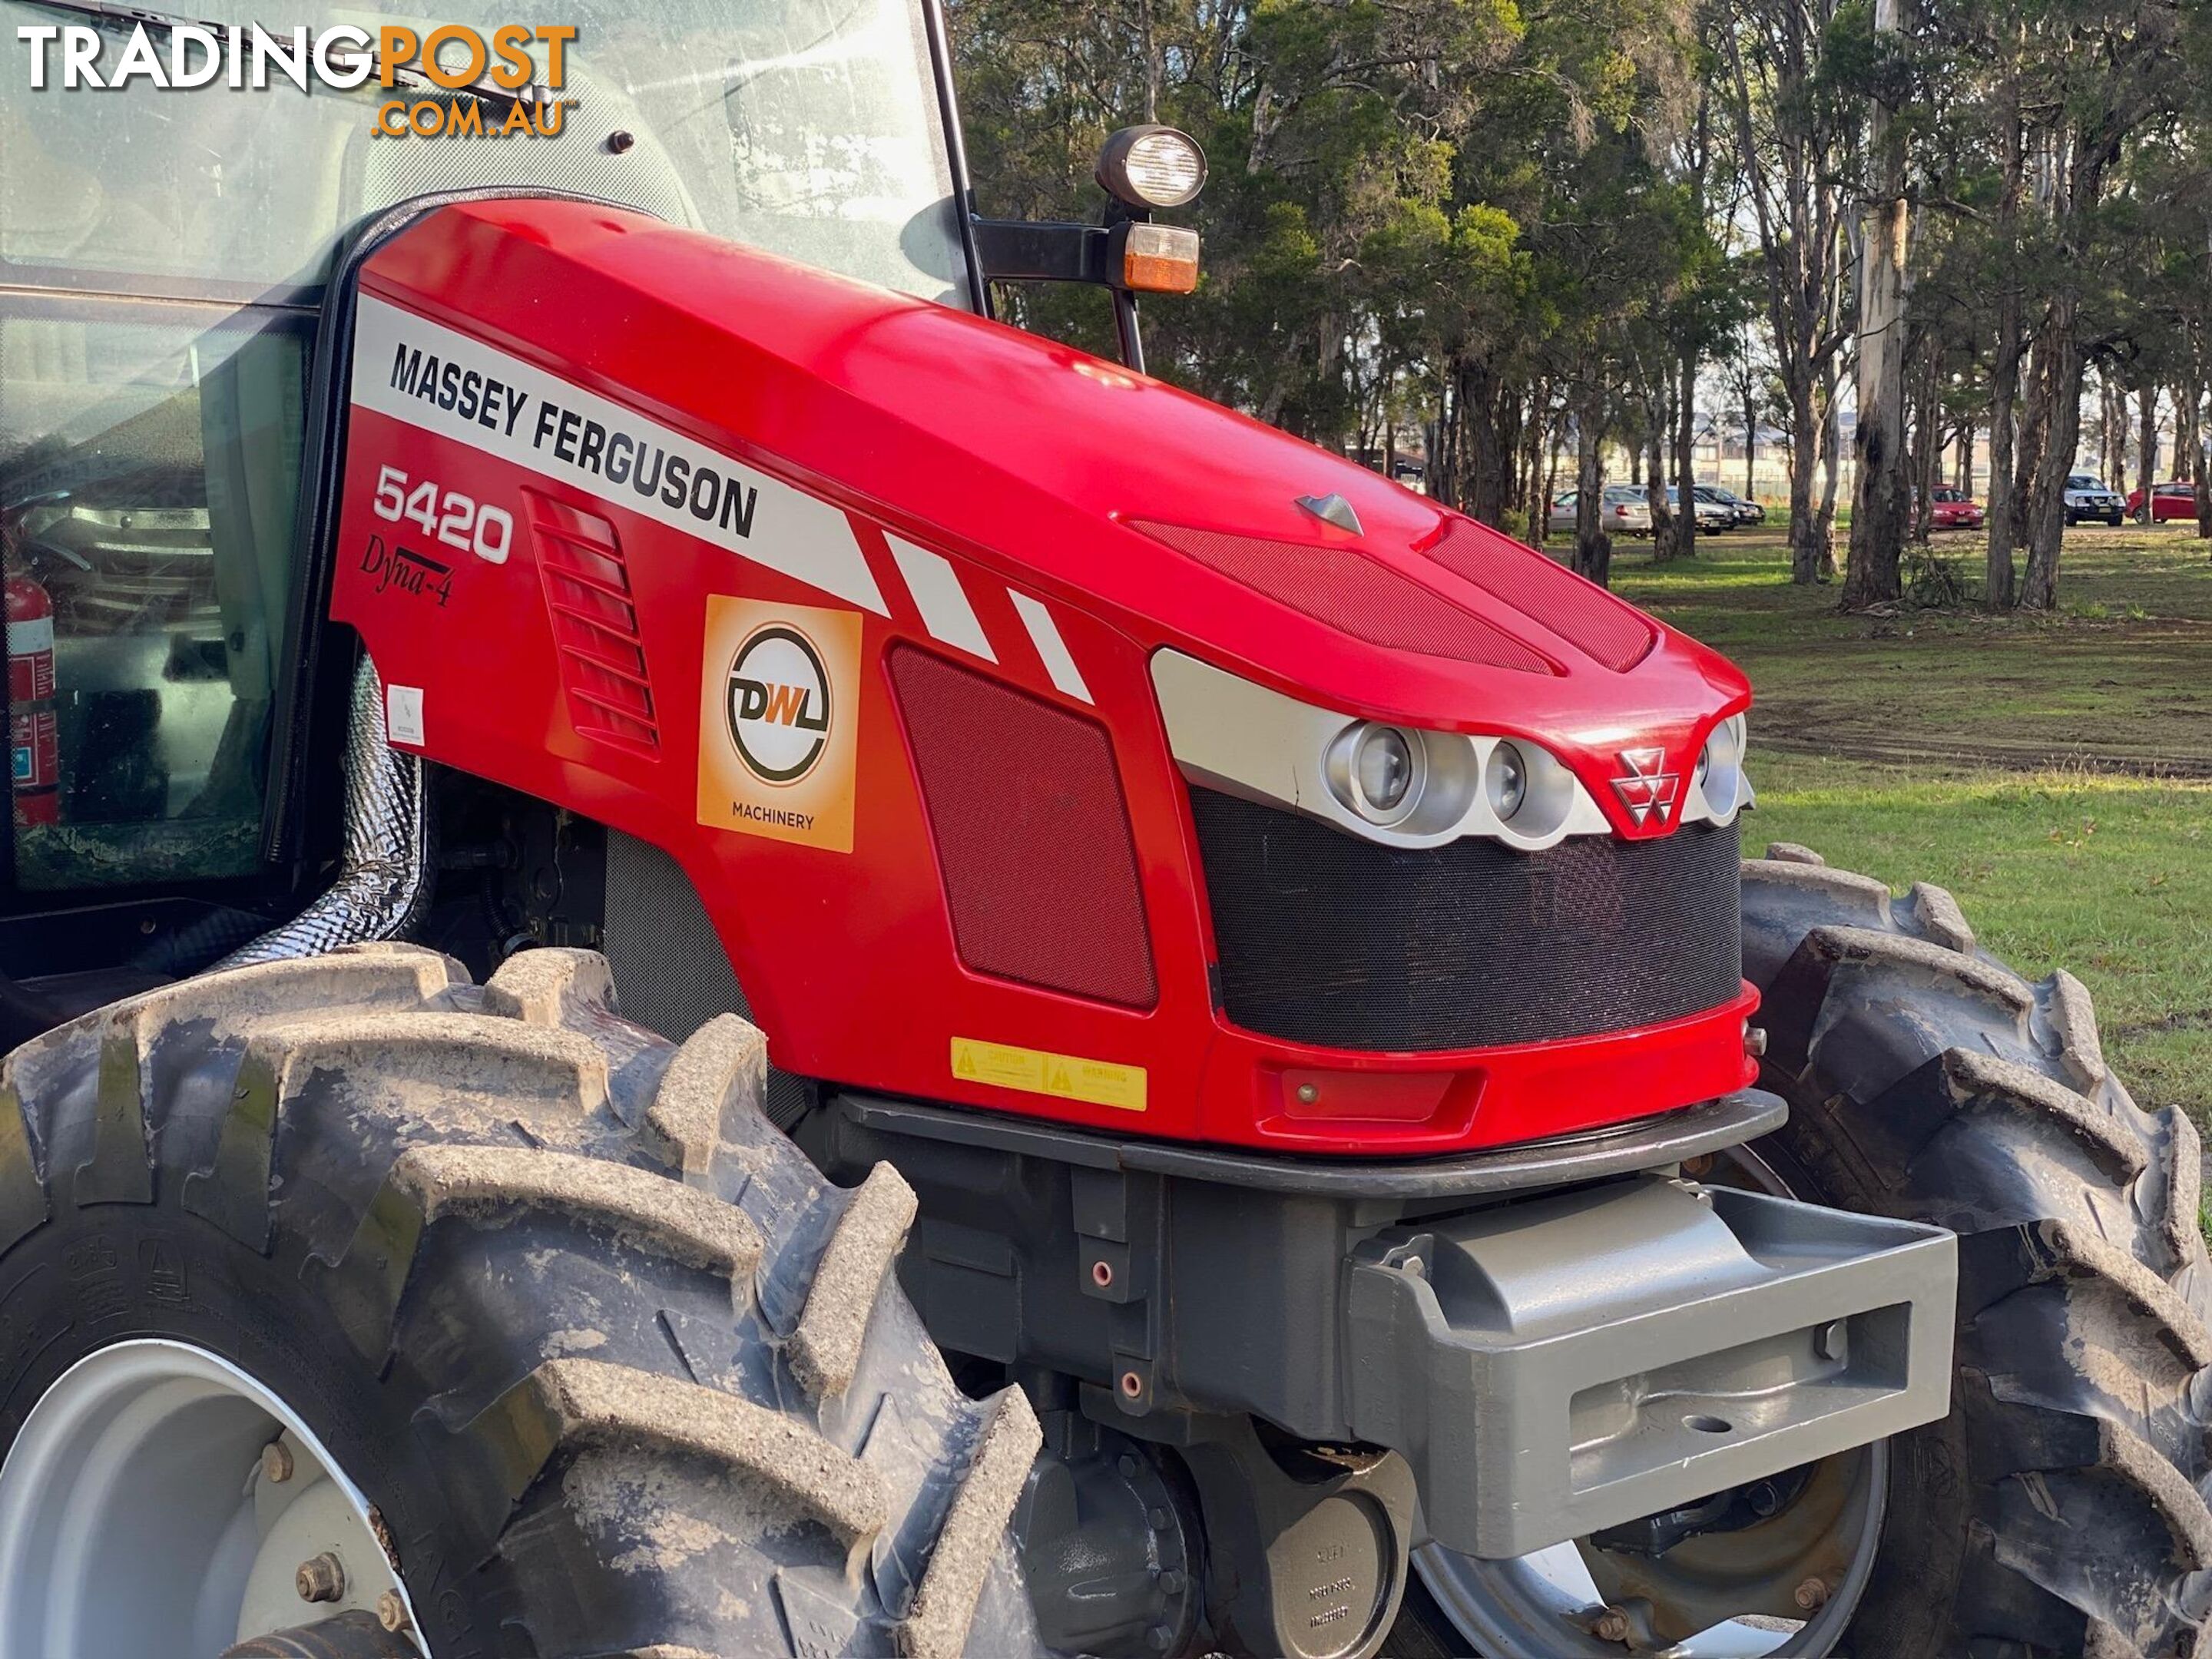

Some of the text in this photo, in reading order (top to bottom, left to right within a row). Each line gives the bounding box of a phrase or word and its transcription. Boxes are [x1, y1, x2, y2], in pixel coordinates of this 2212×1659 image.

[389, 343, 758, 538] MASSEY FERGUSON
[373, 464, 513, 565] 5420
[360, 535, 455, 608] Dyna-4
[729, 677, 828, 732] DWL
[732, 802, 814, 830] MACHINERY
